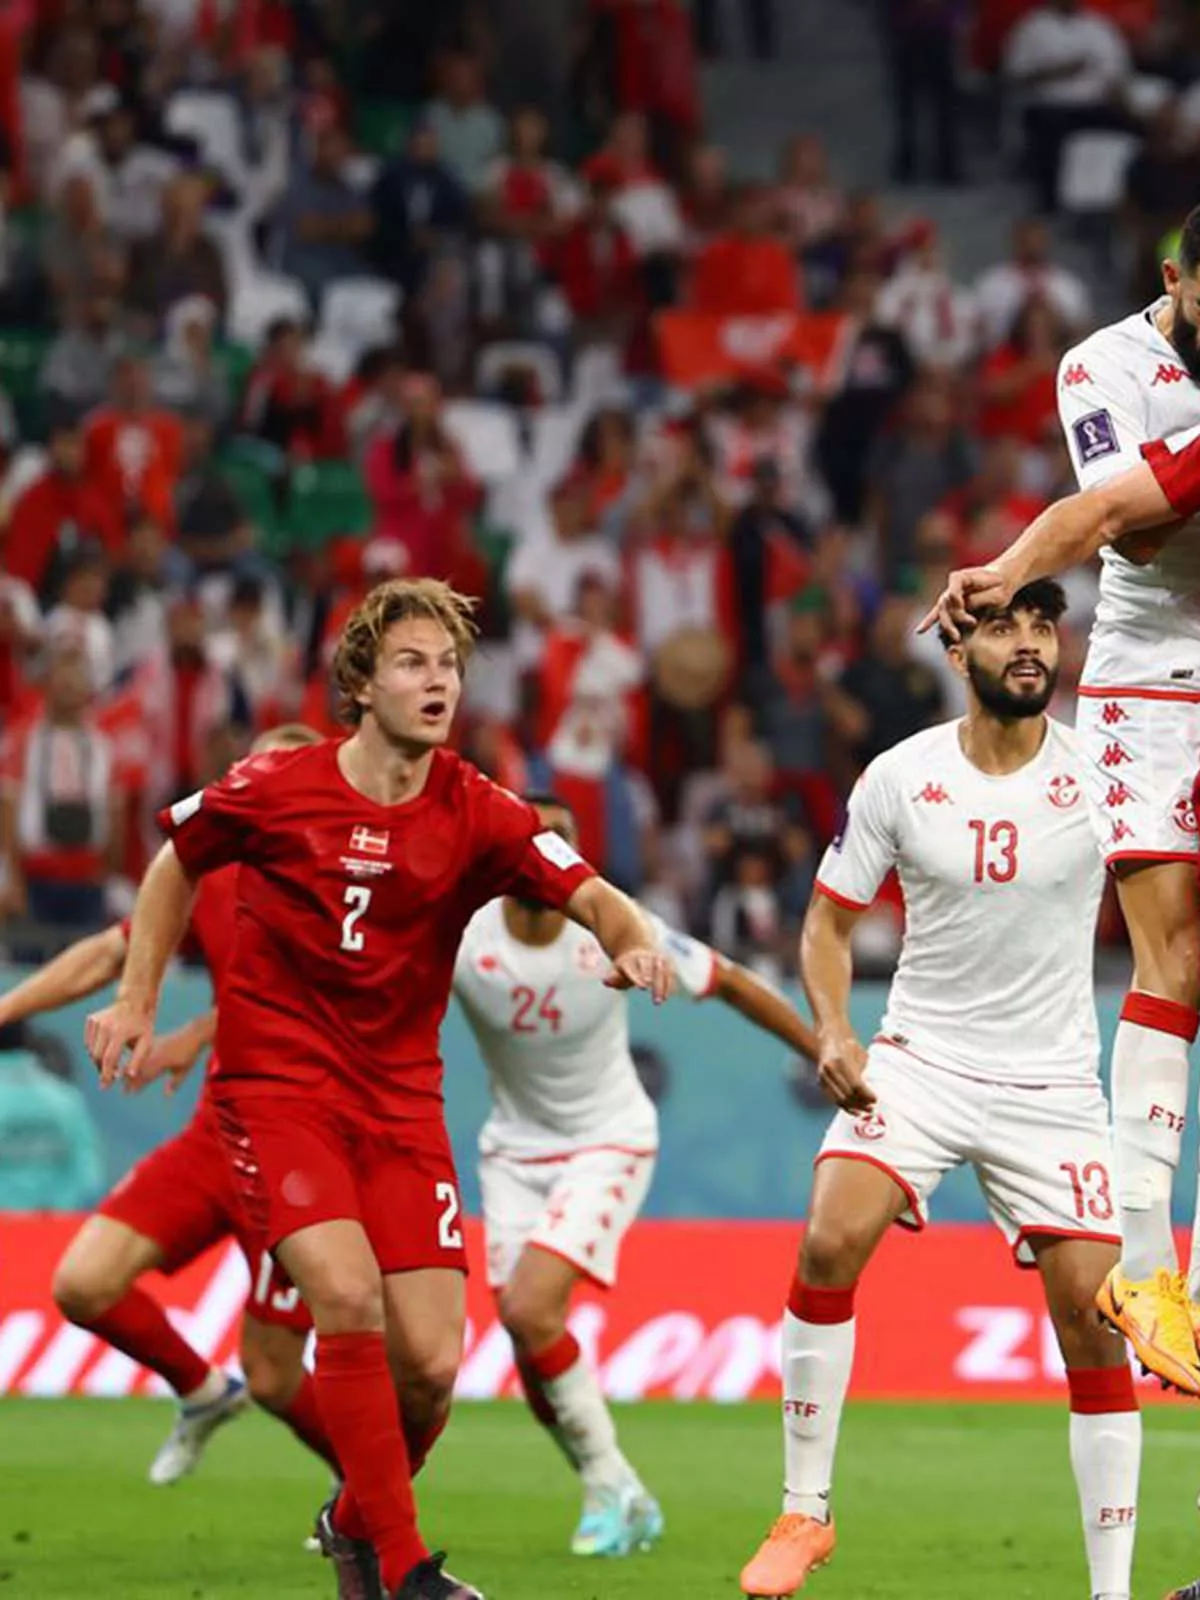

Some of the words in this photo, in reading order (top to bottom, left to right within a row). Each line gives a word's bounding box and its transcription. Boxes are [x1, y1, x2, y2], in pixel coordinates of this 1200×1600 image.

[968, 819, 1018, 883] 13
[341, 886, 371, 951] 2
[511, 985, 561, 1034] 24
[436, 1182, 463, 1248] 2
[1059, 1161, 1114, 1220] 13
